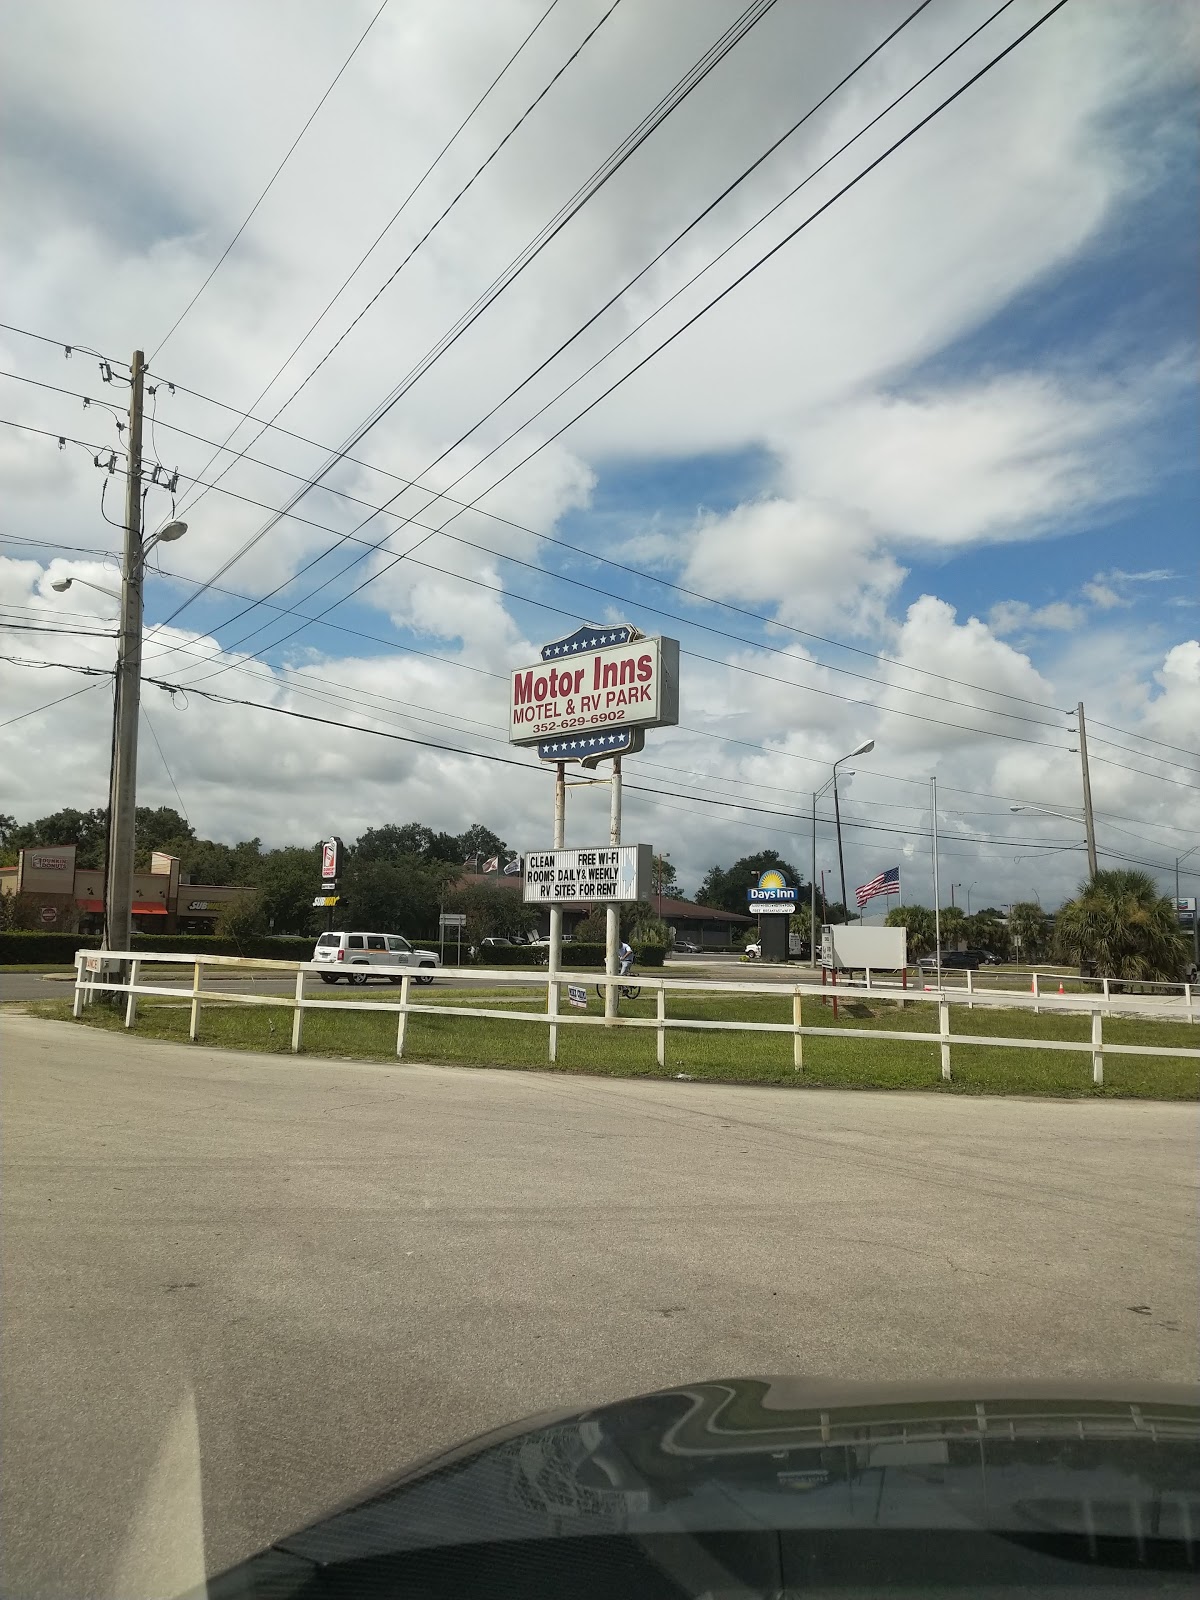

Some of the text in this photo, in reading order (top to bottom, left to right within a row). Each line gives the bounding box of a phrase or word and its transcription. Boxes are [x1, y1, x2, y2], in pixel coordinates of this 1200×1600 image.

[514, 654, 653, 706] Motor Inns
[513, 683, 652, 724] MOTEL & RV PARK
[532, 710, 625, 733] 352-629-6902
[530, 855, 555, 868] CLEAN
[578, 853, 596, 866] FREE
[598, 851, 619, 865] WI-FI
[527, 869, 555, 883] ROOMS
[588, 867, 619, 880] WEEKLY
[540, 882, 618, 897] RV SITES FOR RENT
[751, 889, 795, 900] Days Inn
[312, 896, 340, 907] SUBWAY
